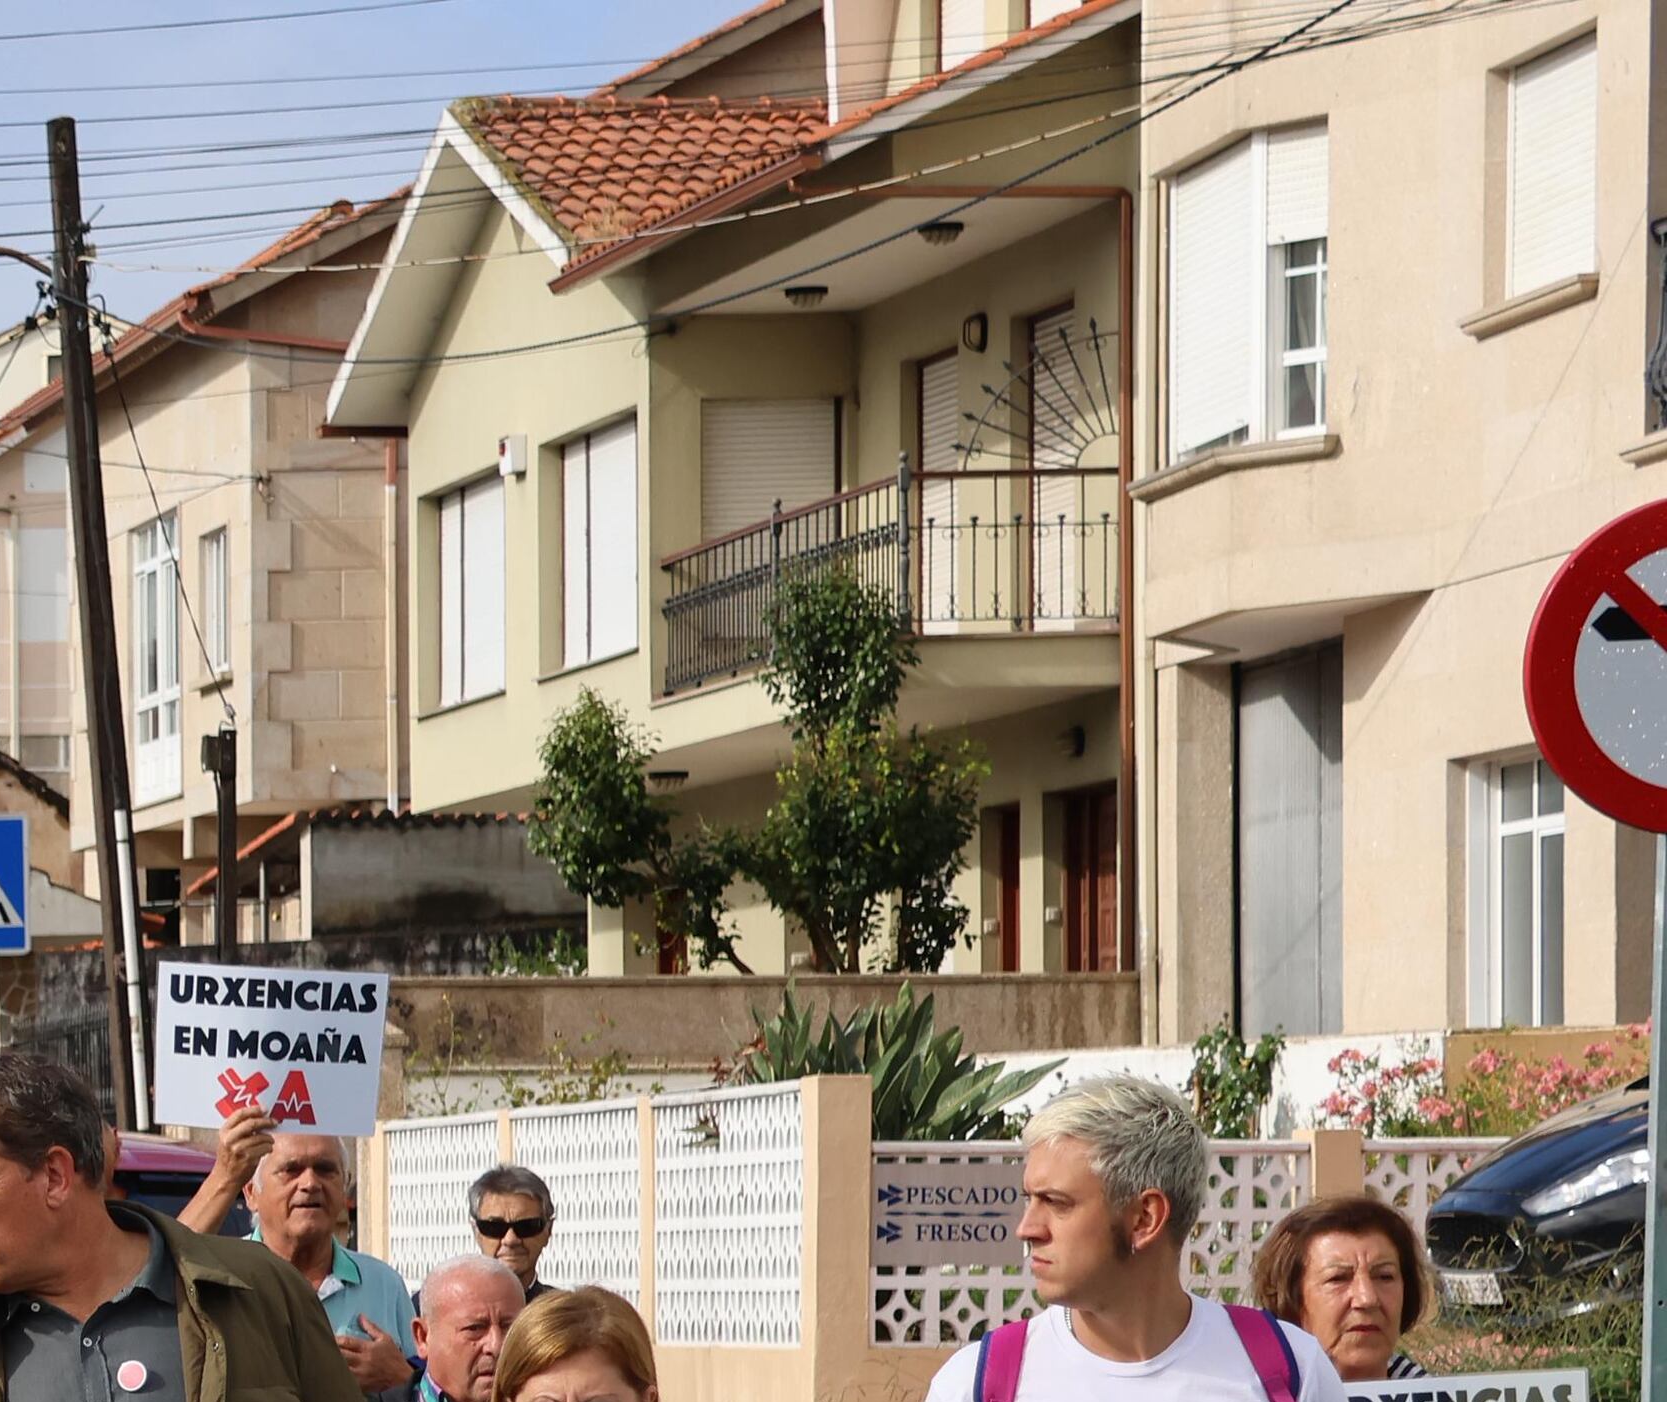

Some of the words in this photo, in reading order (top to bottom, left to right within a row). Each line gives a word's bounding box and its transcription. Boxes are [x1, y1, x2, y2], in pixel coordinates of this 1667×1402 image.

[170, 973, 378, 1014] URXENCIAS
[174, 1025, 218, 1057] EN
[227, 1028, 367, 1064] MOAÑA
[215, 1068, 317, 1126] XA
[906, 1186, 1017, 1205] PESCADO
[916, 1224, 1008, 1243] FRESCO
